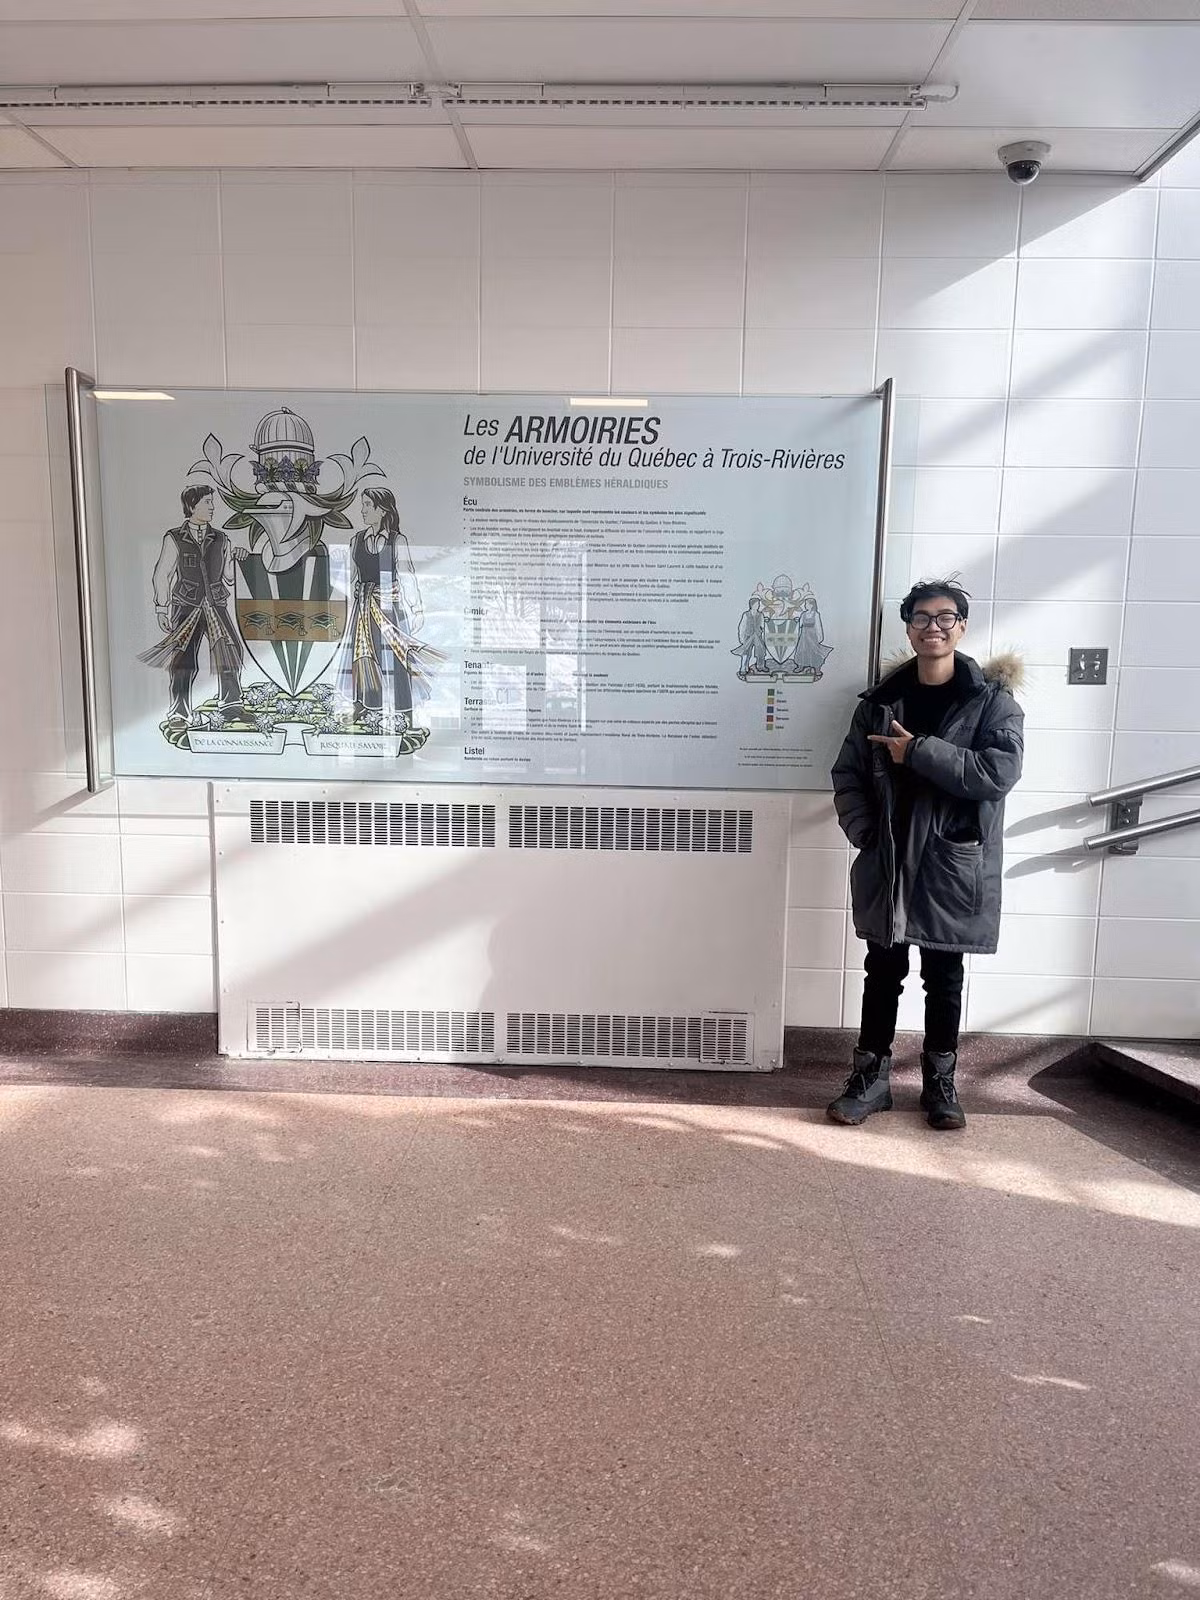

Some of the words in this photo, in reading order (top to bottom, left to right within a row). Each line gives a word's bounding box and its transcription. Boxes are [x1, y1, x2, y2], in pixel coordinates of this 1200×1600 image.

[464, 414, 499, 436] Les
[504, 416, 660, 445] ARMOIRIES
[464, 445, 486, 465] de
[492, 446, 592, 466] l'Université
[599, 447, 622, 466] du
[629, 447, 697, 468] Québec
[703, 448, 714, 468] à
[722, 449, 845, 469] Trois-Rivières
[464, 476, 525, 487] SYMBOLISME
[529, 477, 546, 488] DES
[550, 476, 601, 488] EMBLÈMES
[605, 477, 668, 489] HÉRALDIQUES
[463, 495, 478, 506] Écu
[463, 745, 486, 756] Listel
